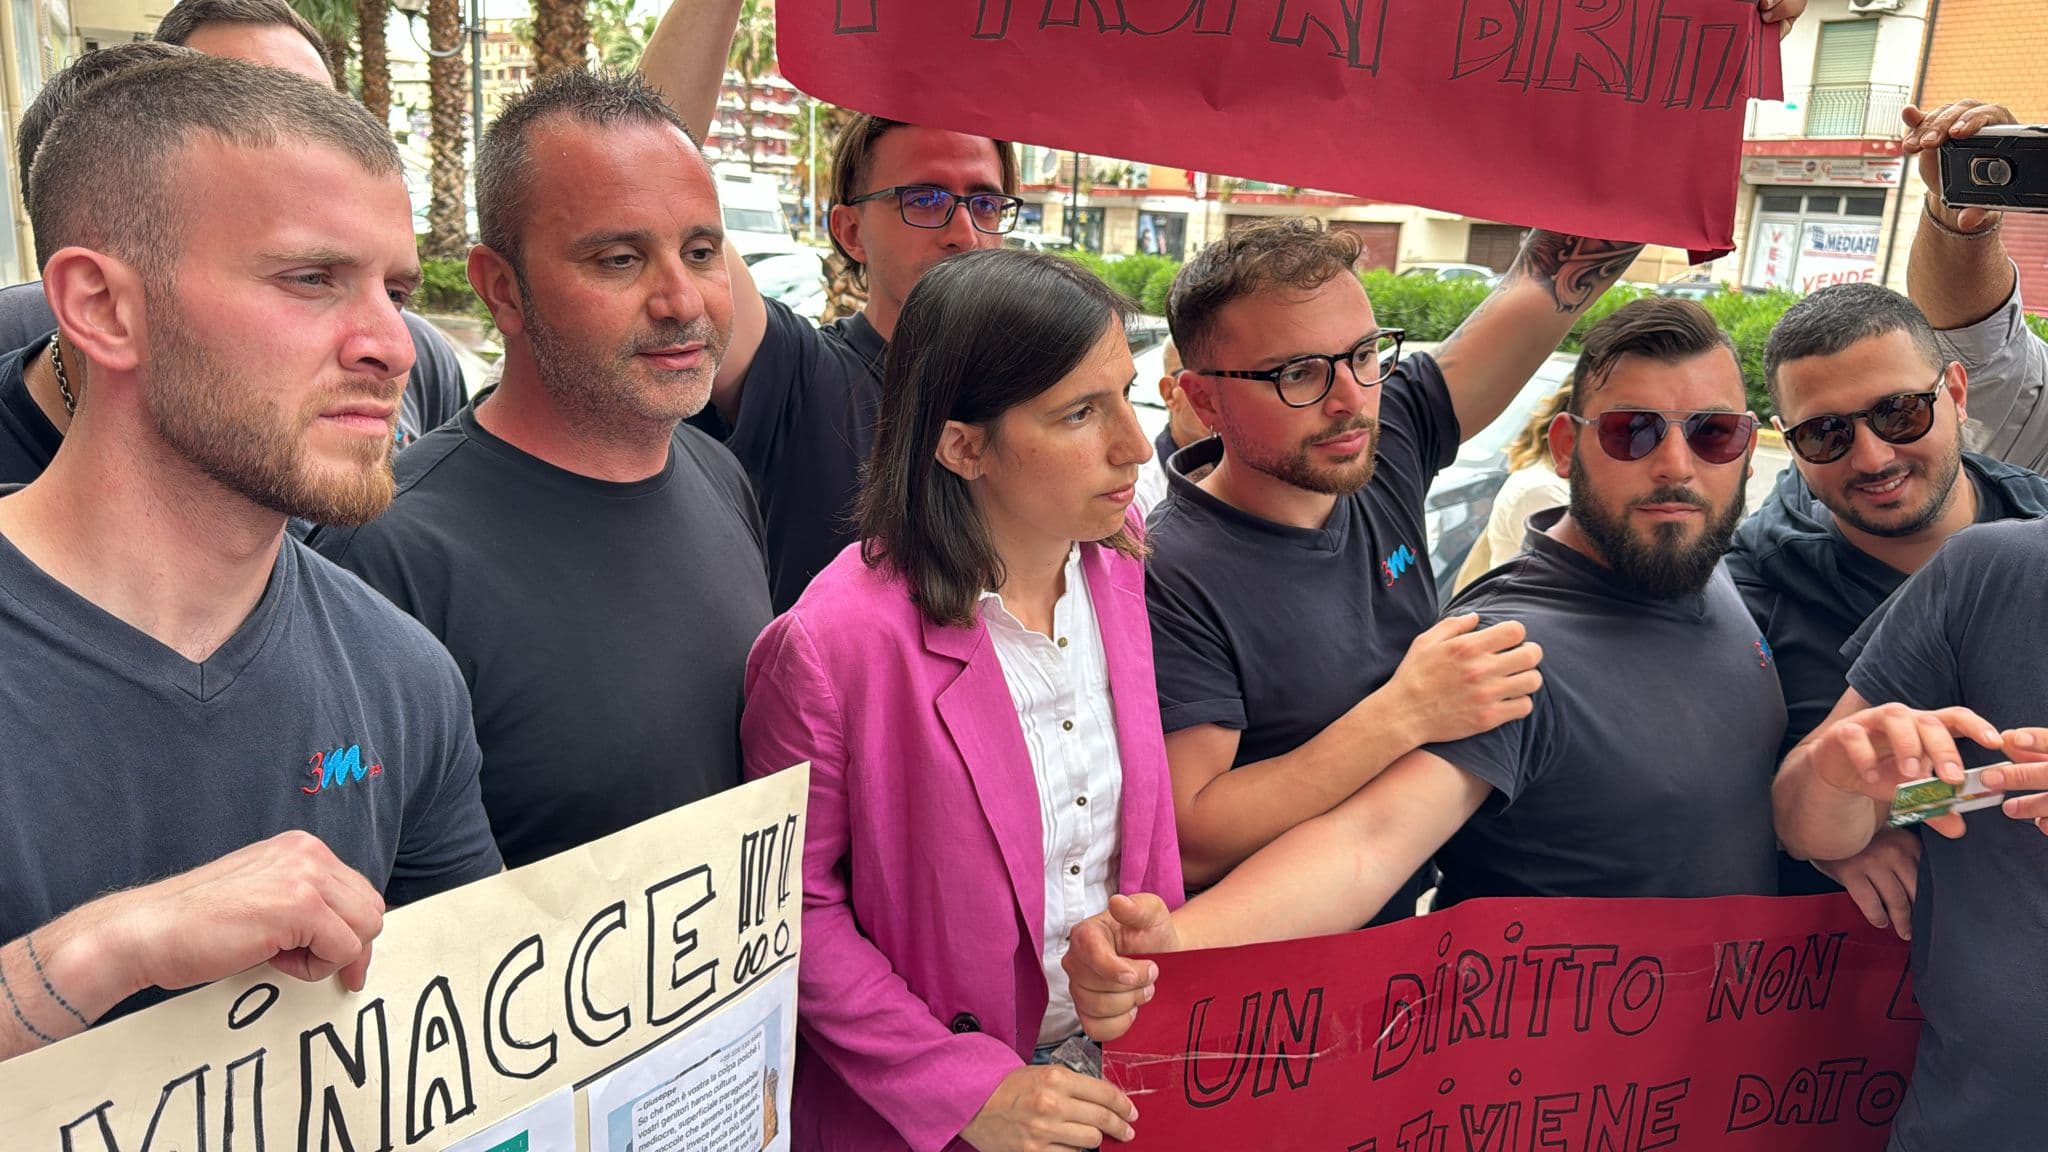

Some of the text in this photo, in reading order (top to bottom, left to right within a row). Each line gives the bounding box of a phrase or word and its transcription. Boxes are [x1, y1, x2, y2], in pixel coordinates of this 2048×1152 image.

[1184, 988, 1323, 1109] UN
[1706, 932, 1848, 1022] NON
[638, 1116, 648, 1126] So
[650, 1106, 663, 1119] che
[665, 1097, 679, 1110] non
[688, 1078, 709, 1096] vostra
[711, 1073, 717, 1082] la
[718, 1061, 736, 1077] colpa
[638, 1074, 736, 1139] vostri genitori hanno cultura
[643, 1087, 677, 1110] Giuseppe
[679, 1098, 718, 1129] superficiale
[1726, 1057, 1907, 1135] DATO
[685, 1125, 699, 1138] che
[700, 1108, 724, 1129] almeno
[726, 1102, 732, 1112] lo
[686, 1132, 710, 1151] invece
[711, 1121, 721, 1136] per
